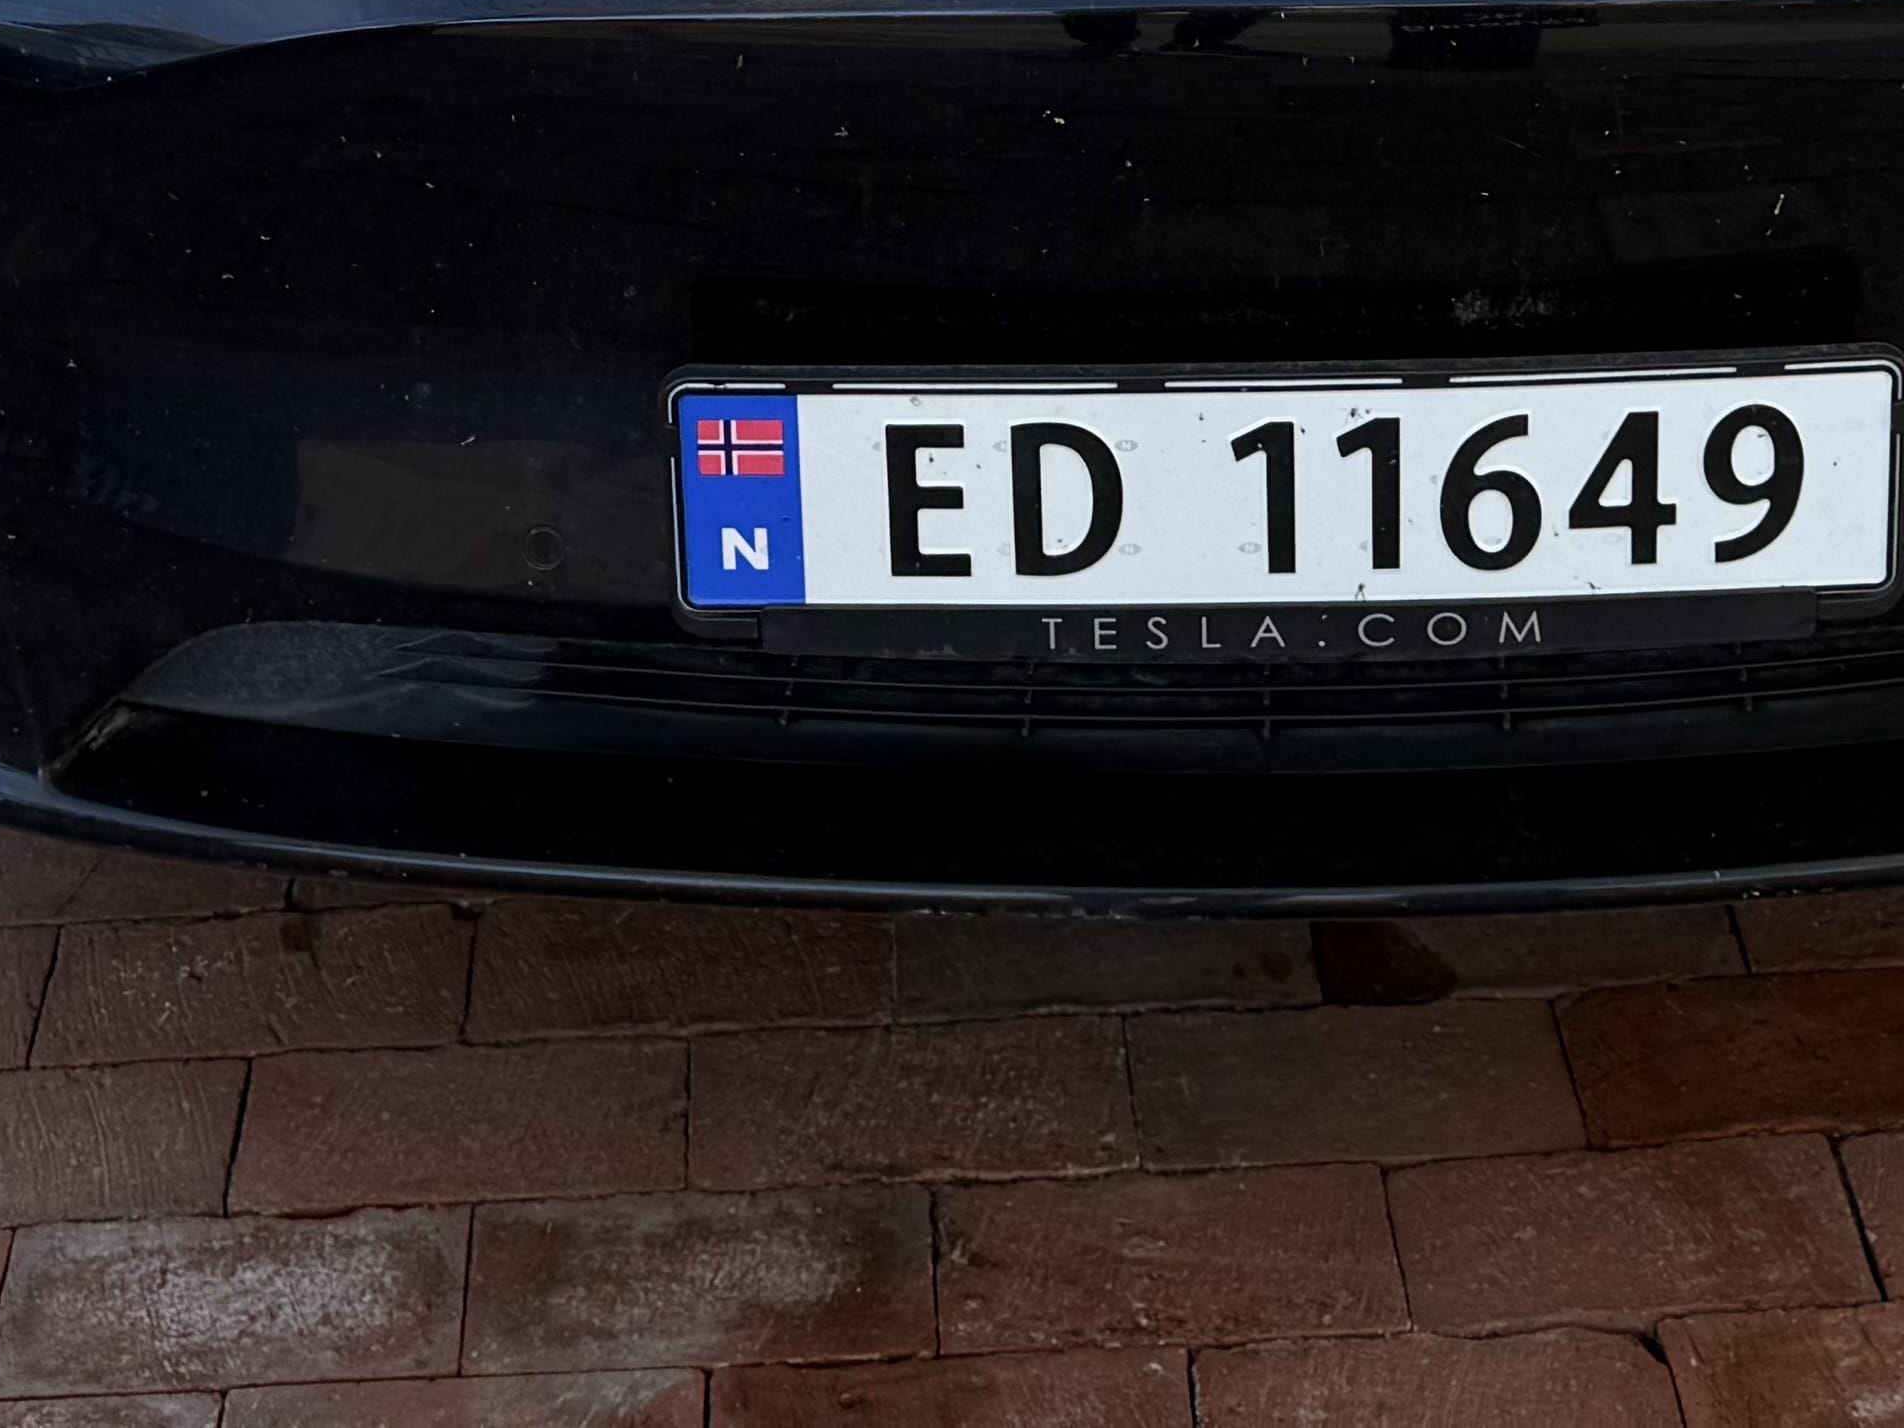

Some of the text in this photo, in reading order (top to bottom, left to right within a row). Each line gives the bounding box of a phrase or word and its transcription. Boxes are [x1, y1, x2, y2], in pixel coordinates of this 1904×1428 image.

[721, 403, 1805, 577] N ED 11649
